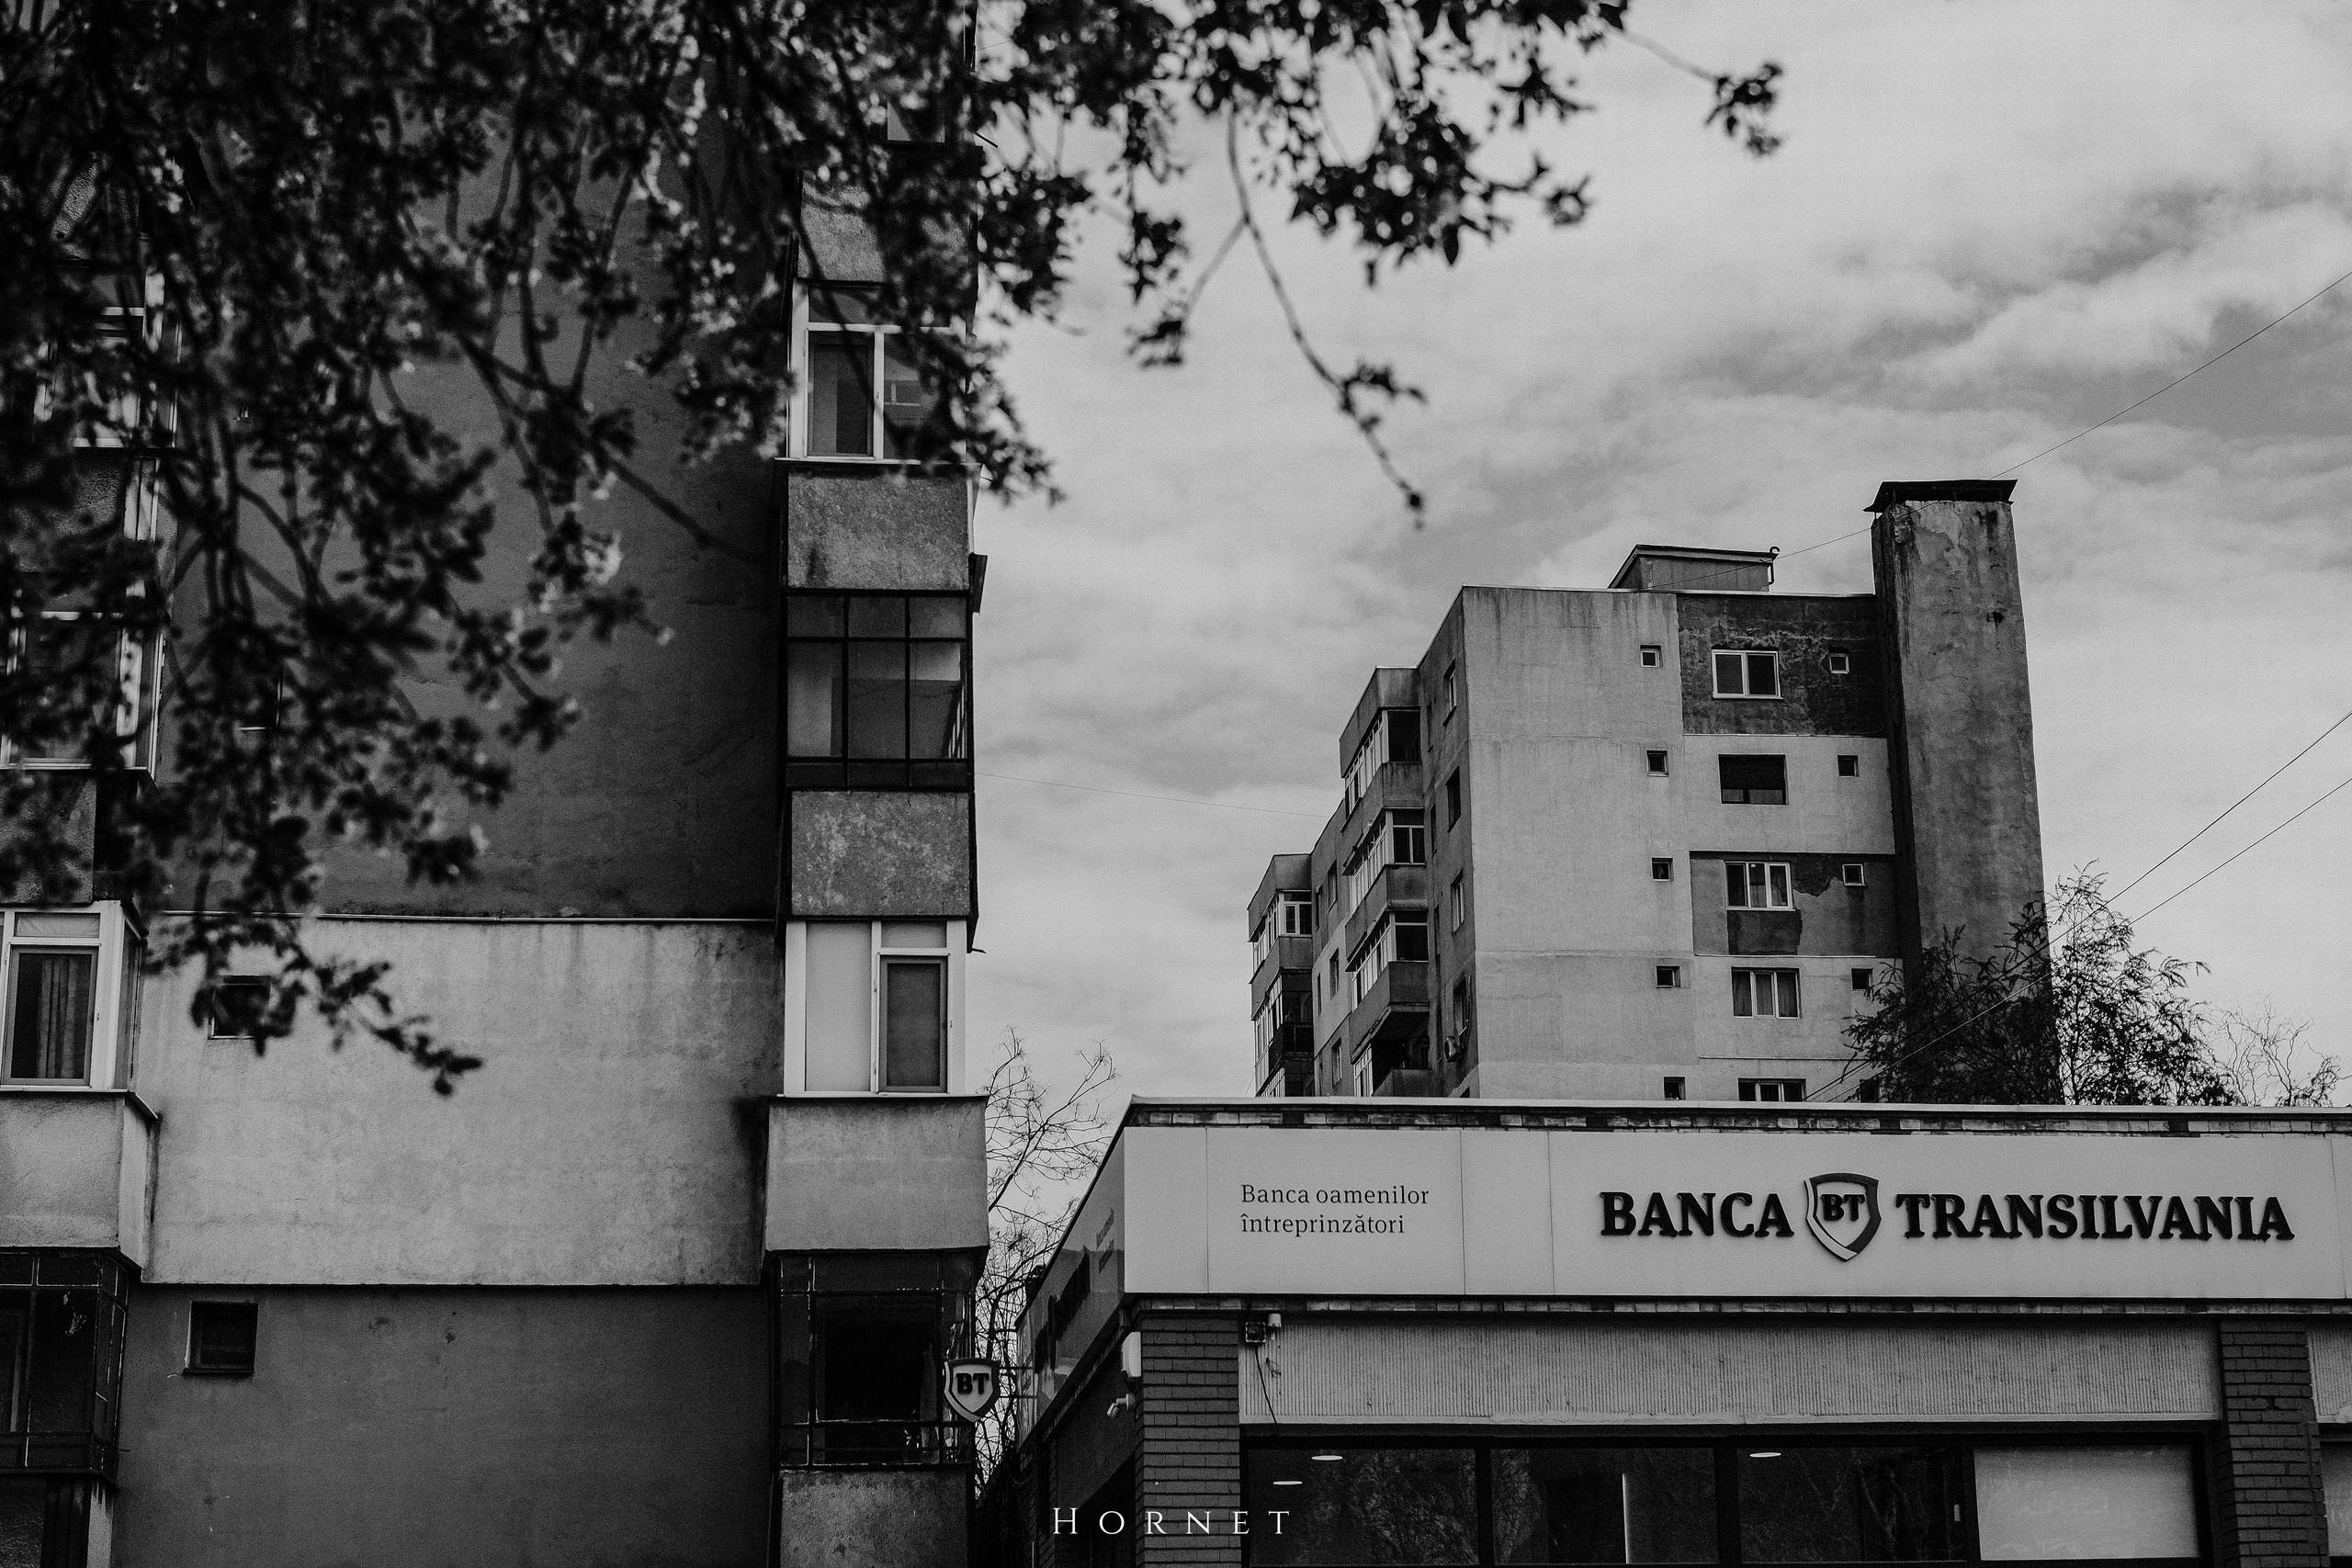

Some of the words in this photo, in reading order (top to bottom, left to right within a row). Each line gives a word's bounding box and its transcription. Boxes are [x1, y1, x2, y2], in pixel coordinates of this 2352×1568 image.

[1240, 1183, 1310, 1204] Banca
[1315, 1184, 1430, 1205] oamenilor
[1240, 1212, 1406, 1237] întreprinzători
[1599, 1190, 1795, 1238] BANCA
[1819, 1191, 1867, 1223] BT
[1894, 1192, 2296, 1242] TRANSILVANIA
[956, 1372, 989, 1395] BT
